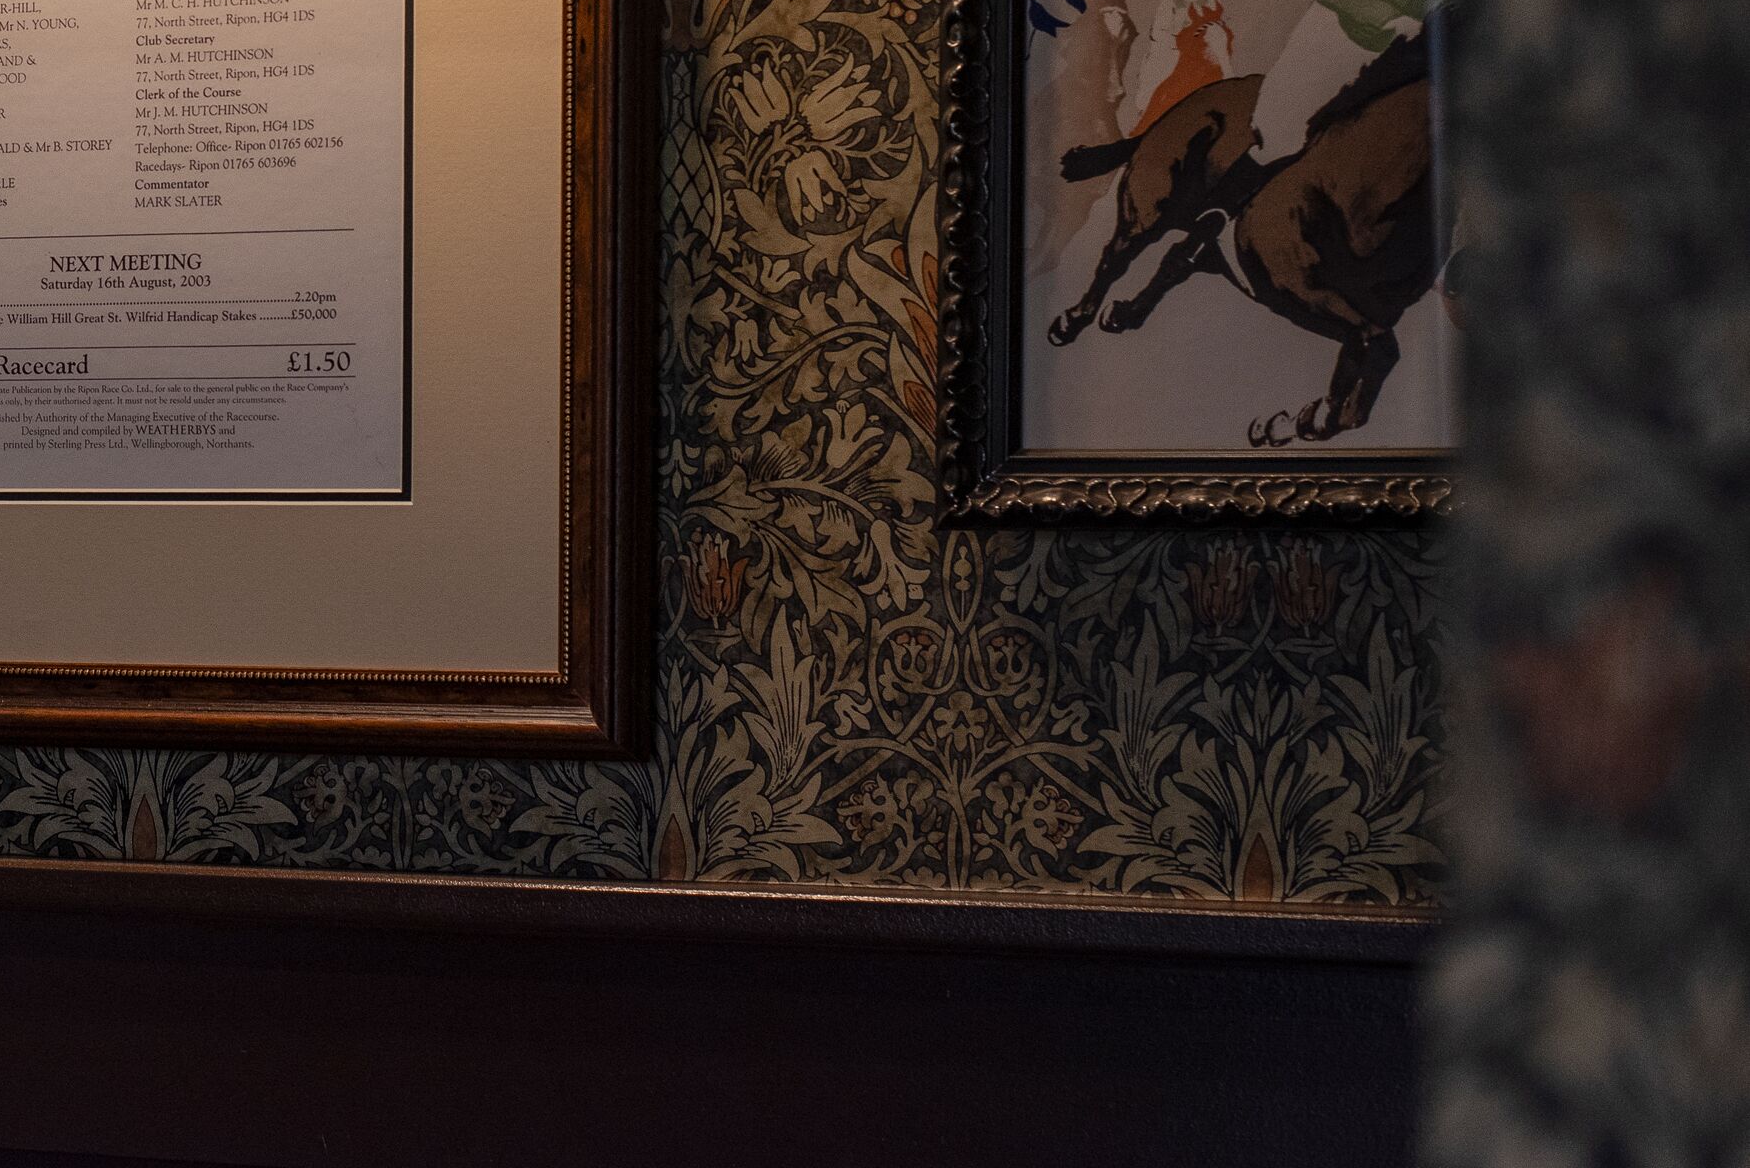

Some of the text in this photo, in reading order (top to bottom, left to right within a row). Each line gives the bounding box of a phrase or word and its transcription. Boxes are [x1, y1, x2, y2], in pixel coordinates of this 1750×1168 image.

[135, 33, 215, 46] Club Secretary
[135, 86, 241, 100] Clerk of the Course
[135, 118, 314, 136] 77, North Street, Ripon, HG4 1DS
[134, 136, 343, 156] Telephone: Office- Ripon 01765 602156
[134, 178, 209, 190] Commentator
[134, 194, 222, 208] MARK SLATER
[49, 253, 201, 272] NEXT MEETING
[40, 274, 211, 291] Saturday 16th August, 2003
[294, 290, 336, 304] 2.20pm
[6, 313, 48, 324] William
[50, 312, 71, 323] Hill
[74, 312, 104, 323] Great
[107, 311, 121, 323] St.
[125, 310, 163, 322] Wilfrid
[166, 310, 218, 324] Handicap
[221, 309, 256, 321] Stakes
[290, 308, 337, 320] £50,000
[286, 350, 350, 372] £1.50
[22, 412, 33, 424] by
[34, 411, 77, 424] Authority
[78, 411, 89, 422] of
[90, 411, 104, 422] the
[106, 412, 150, 423] Managing
[152, 411, 195, 422] Executive
[197, 411, 208, 421] of
[209, 411, 223, 421] the
[226, 411, 279, 421] Racecourse.
[21, 423, 235, 437] Designed and compiled by WEATHERBYS and
[2, 438, 254, 451] printed by Sterling Press Ltd., Wellingborough, Northants.
